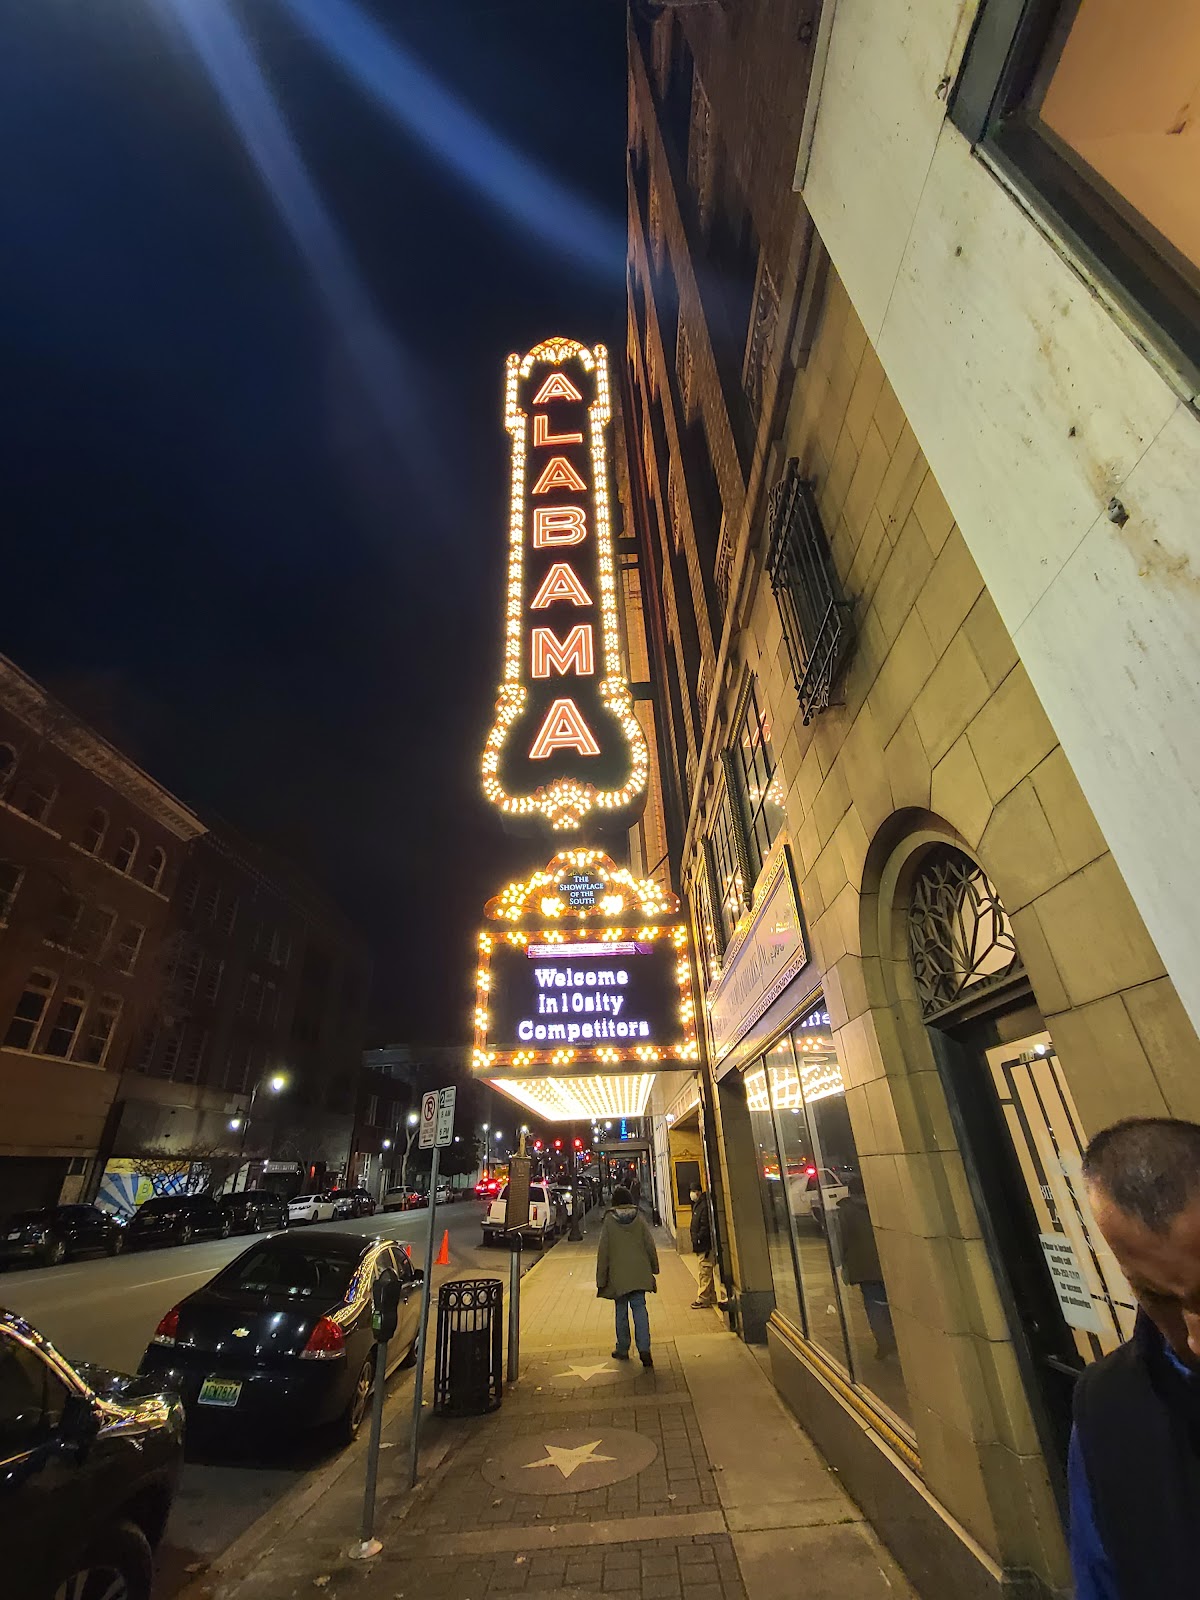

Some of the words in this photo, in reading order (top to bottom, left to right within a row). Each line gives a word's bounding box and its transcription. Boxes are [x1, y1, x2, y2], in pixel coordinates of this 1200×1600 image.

[529, 372, 601, 759] ALABAMA
[573, 875, 589, 883] THE
[559, 883, 605, 891] SHOWPLACE
[569, 897, 595, 905] SOUTH
[534, 967, 629, 988] Welcome
[518, 1018, 650, 1042] Competitors
